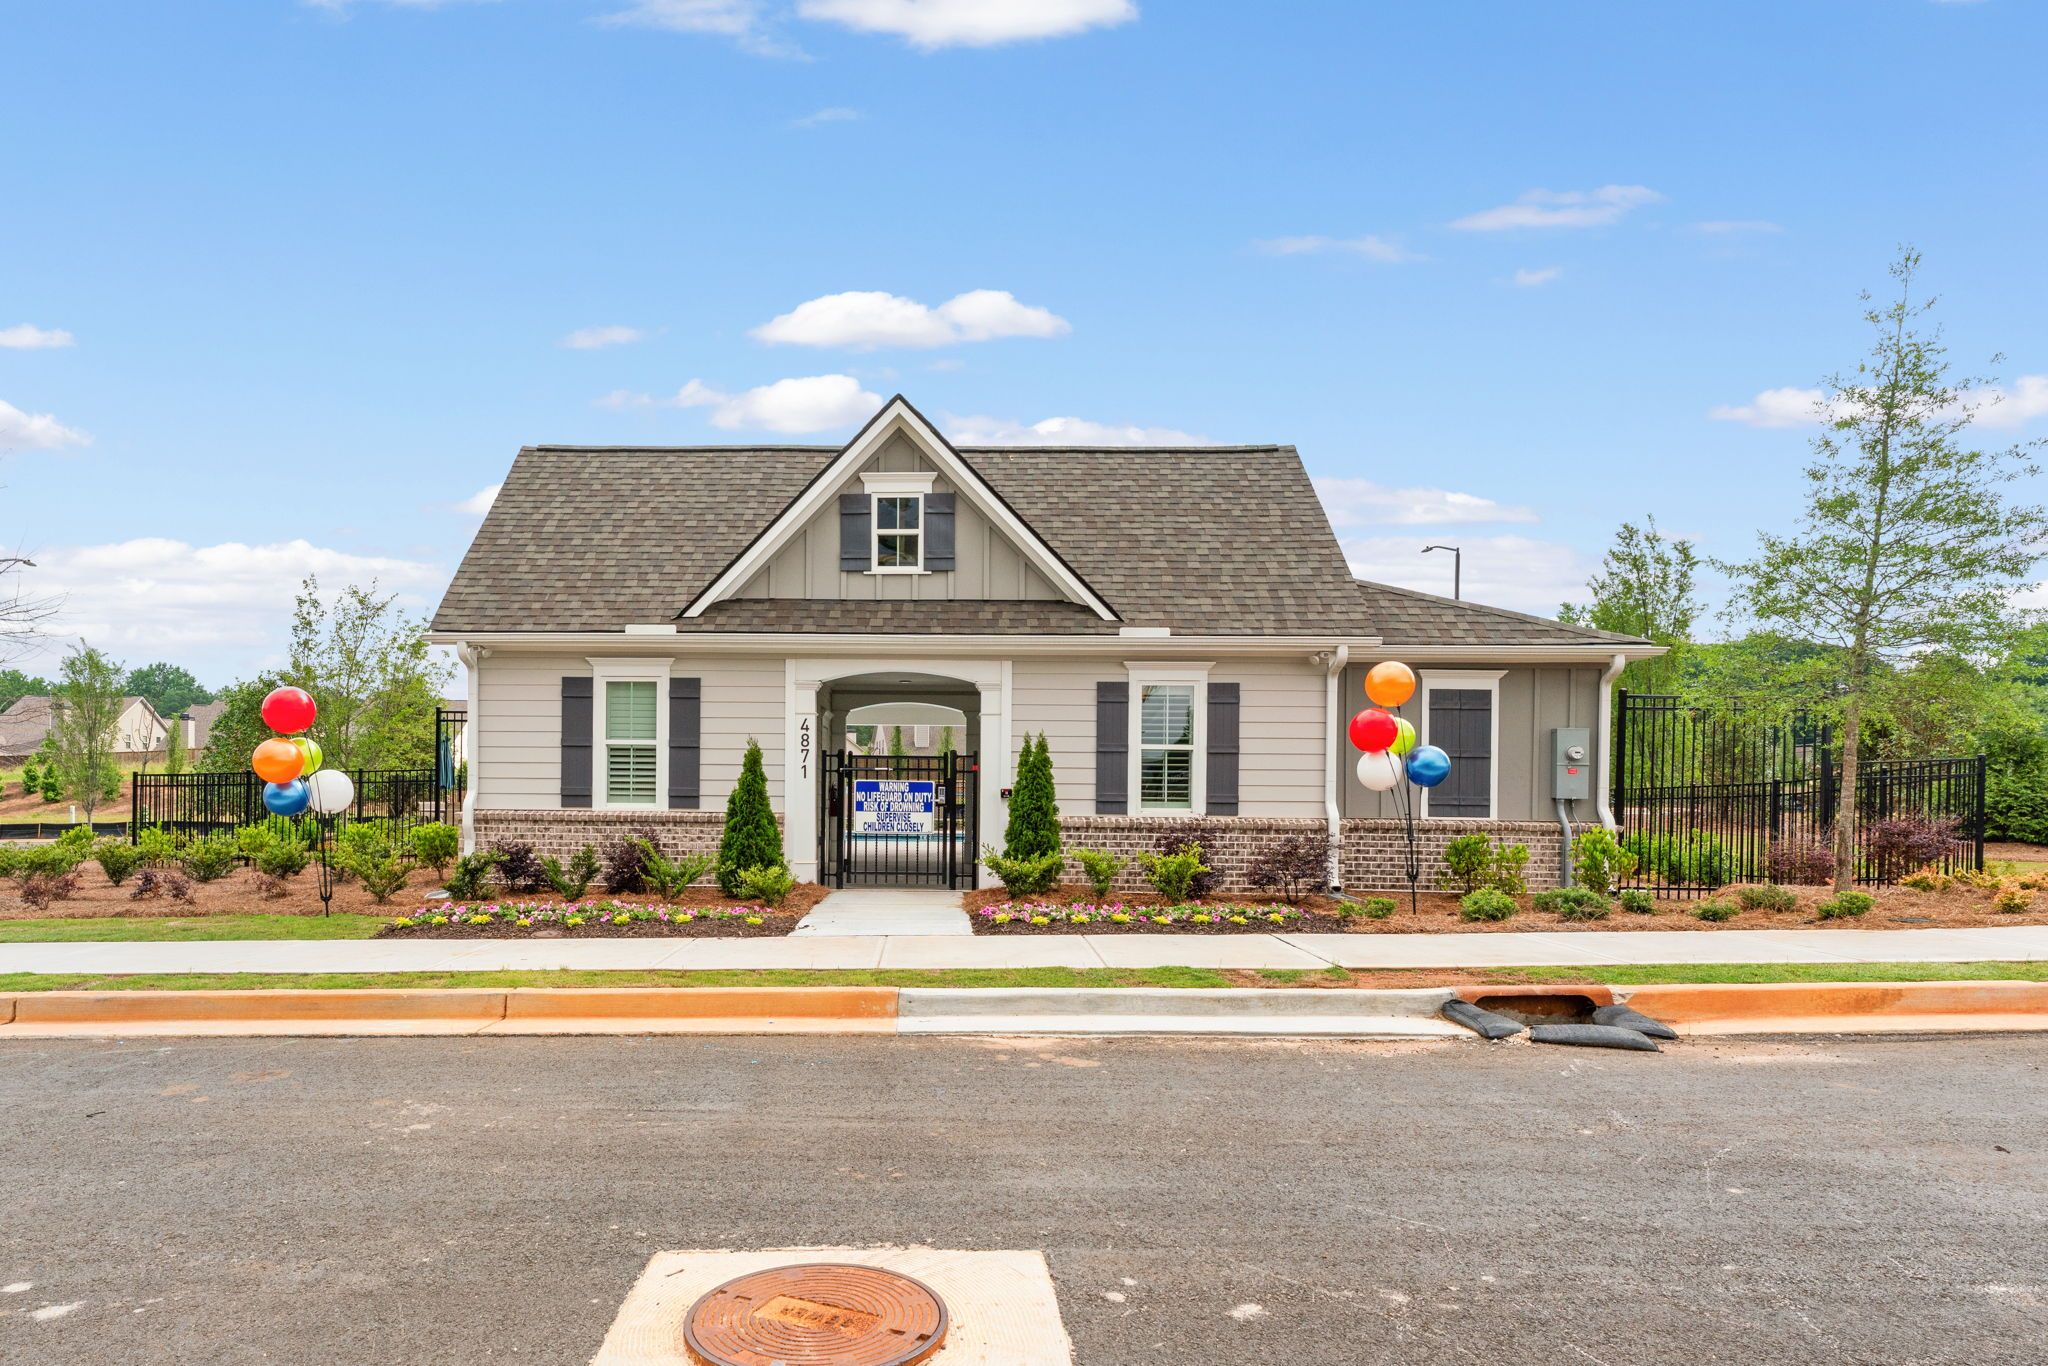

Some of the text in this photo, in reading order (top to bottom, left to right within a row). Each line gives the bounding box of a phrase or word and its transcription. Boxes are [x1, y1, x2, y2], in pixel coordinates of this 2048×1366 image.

[800, 718, 810, 779] 4871
[879, 782, 909, 792] WARNING
[856, 792, 932, 802] NO LIFEGUARD ON DUTY
[863, 802, 925, 812] RISK OF DROWNING
[876, 813, 911, 822] SUPERVISE
[863, 822, 924, 832] CHILDREN CLOSELY
